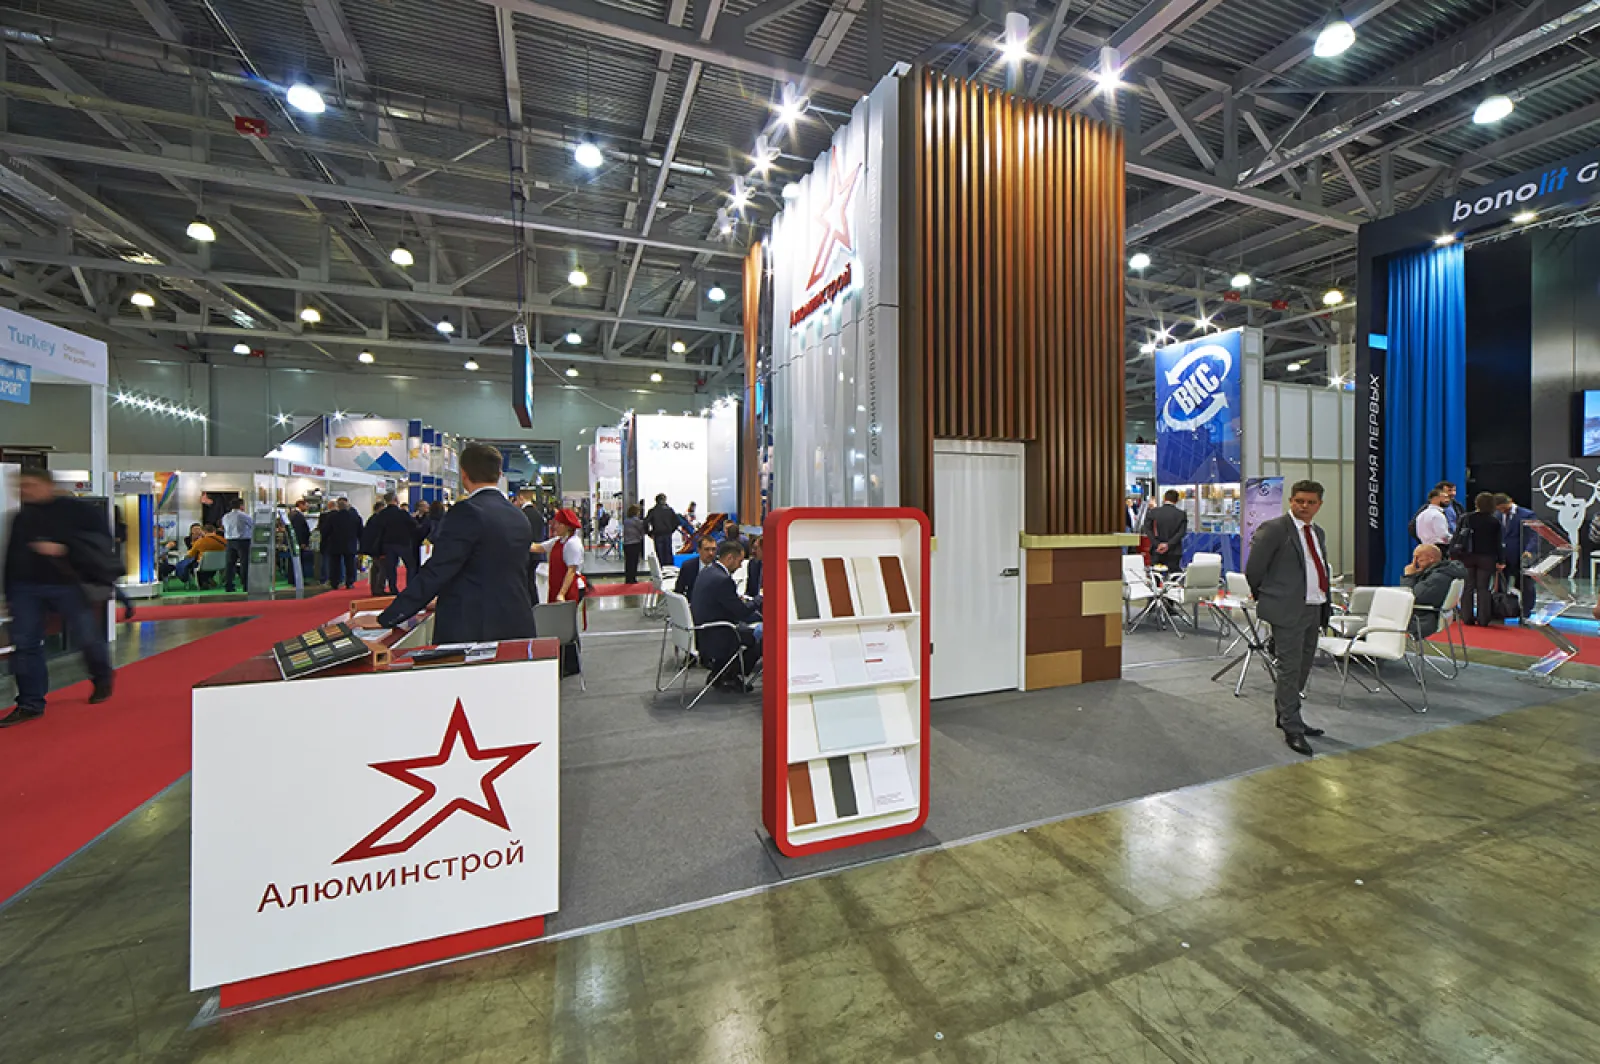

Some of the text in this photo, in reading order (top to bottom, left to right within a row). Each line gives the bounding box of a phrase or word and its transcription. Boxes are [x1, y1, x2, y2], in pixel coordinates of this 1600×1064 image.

[1452, 166, 1569, 222] bonolit
[7, 325, 56, 356] Turkey
[1368, 374, 1380, 450] ПЕРВЫХ
[673, 440, 695, 451] ONE
[257, 839, 526, 913] Алюминстрой
